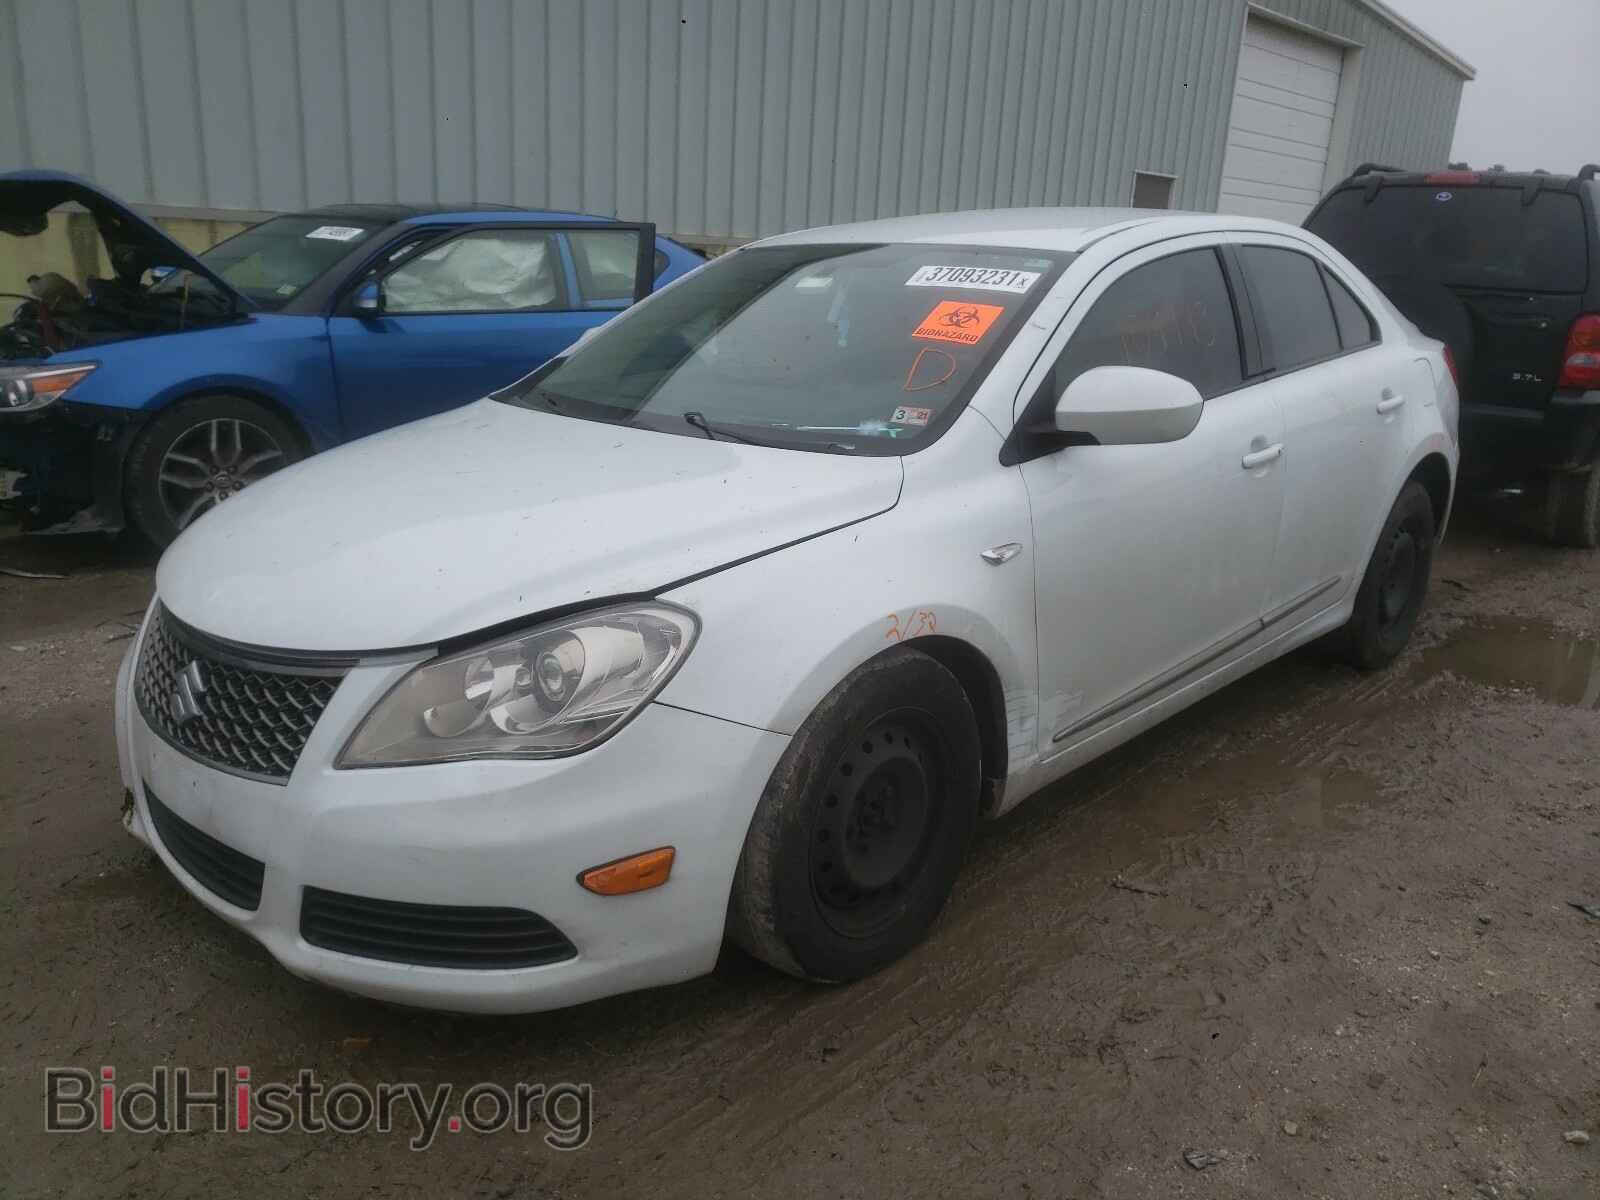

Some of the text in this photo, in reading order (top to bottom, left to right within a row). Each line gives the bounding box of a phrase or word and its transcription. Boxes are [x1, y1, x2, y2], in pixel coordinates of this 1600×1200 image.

[925, 266, 1021, 287] 37093231
[914, 327, 979, 343] BIOHAZARD
[895, 409, 906, 420] 3
